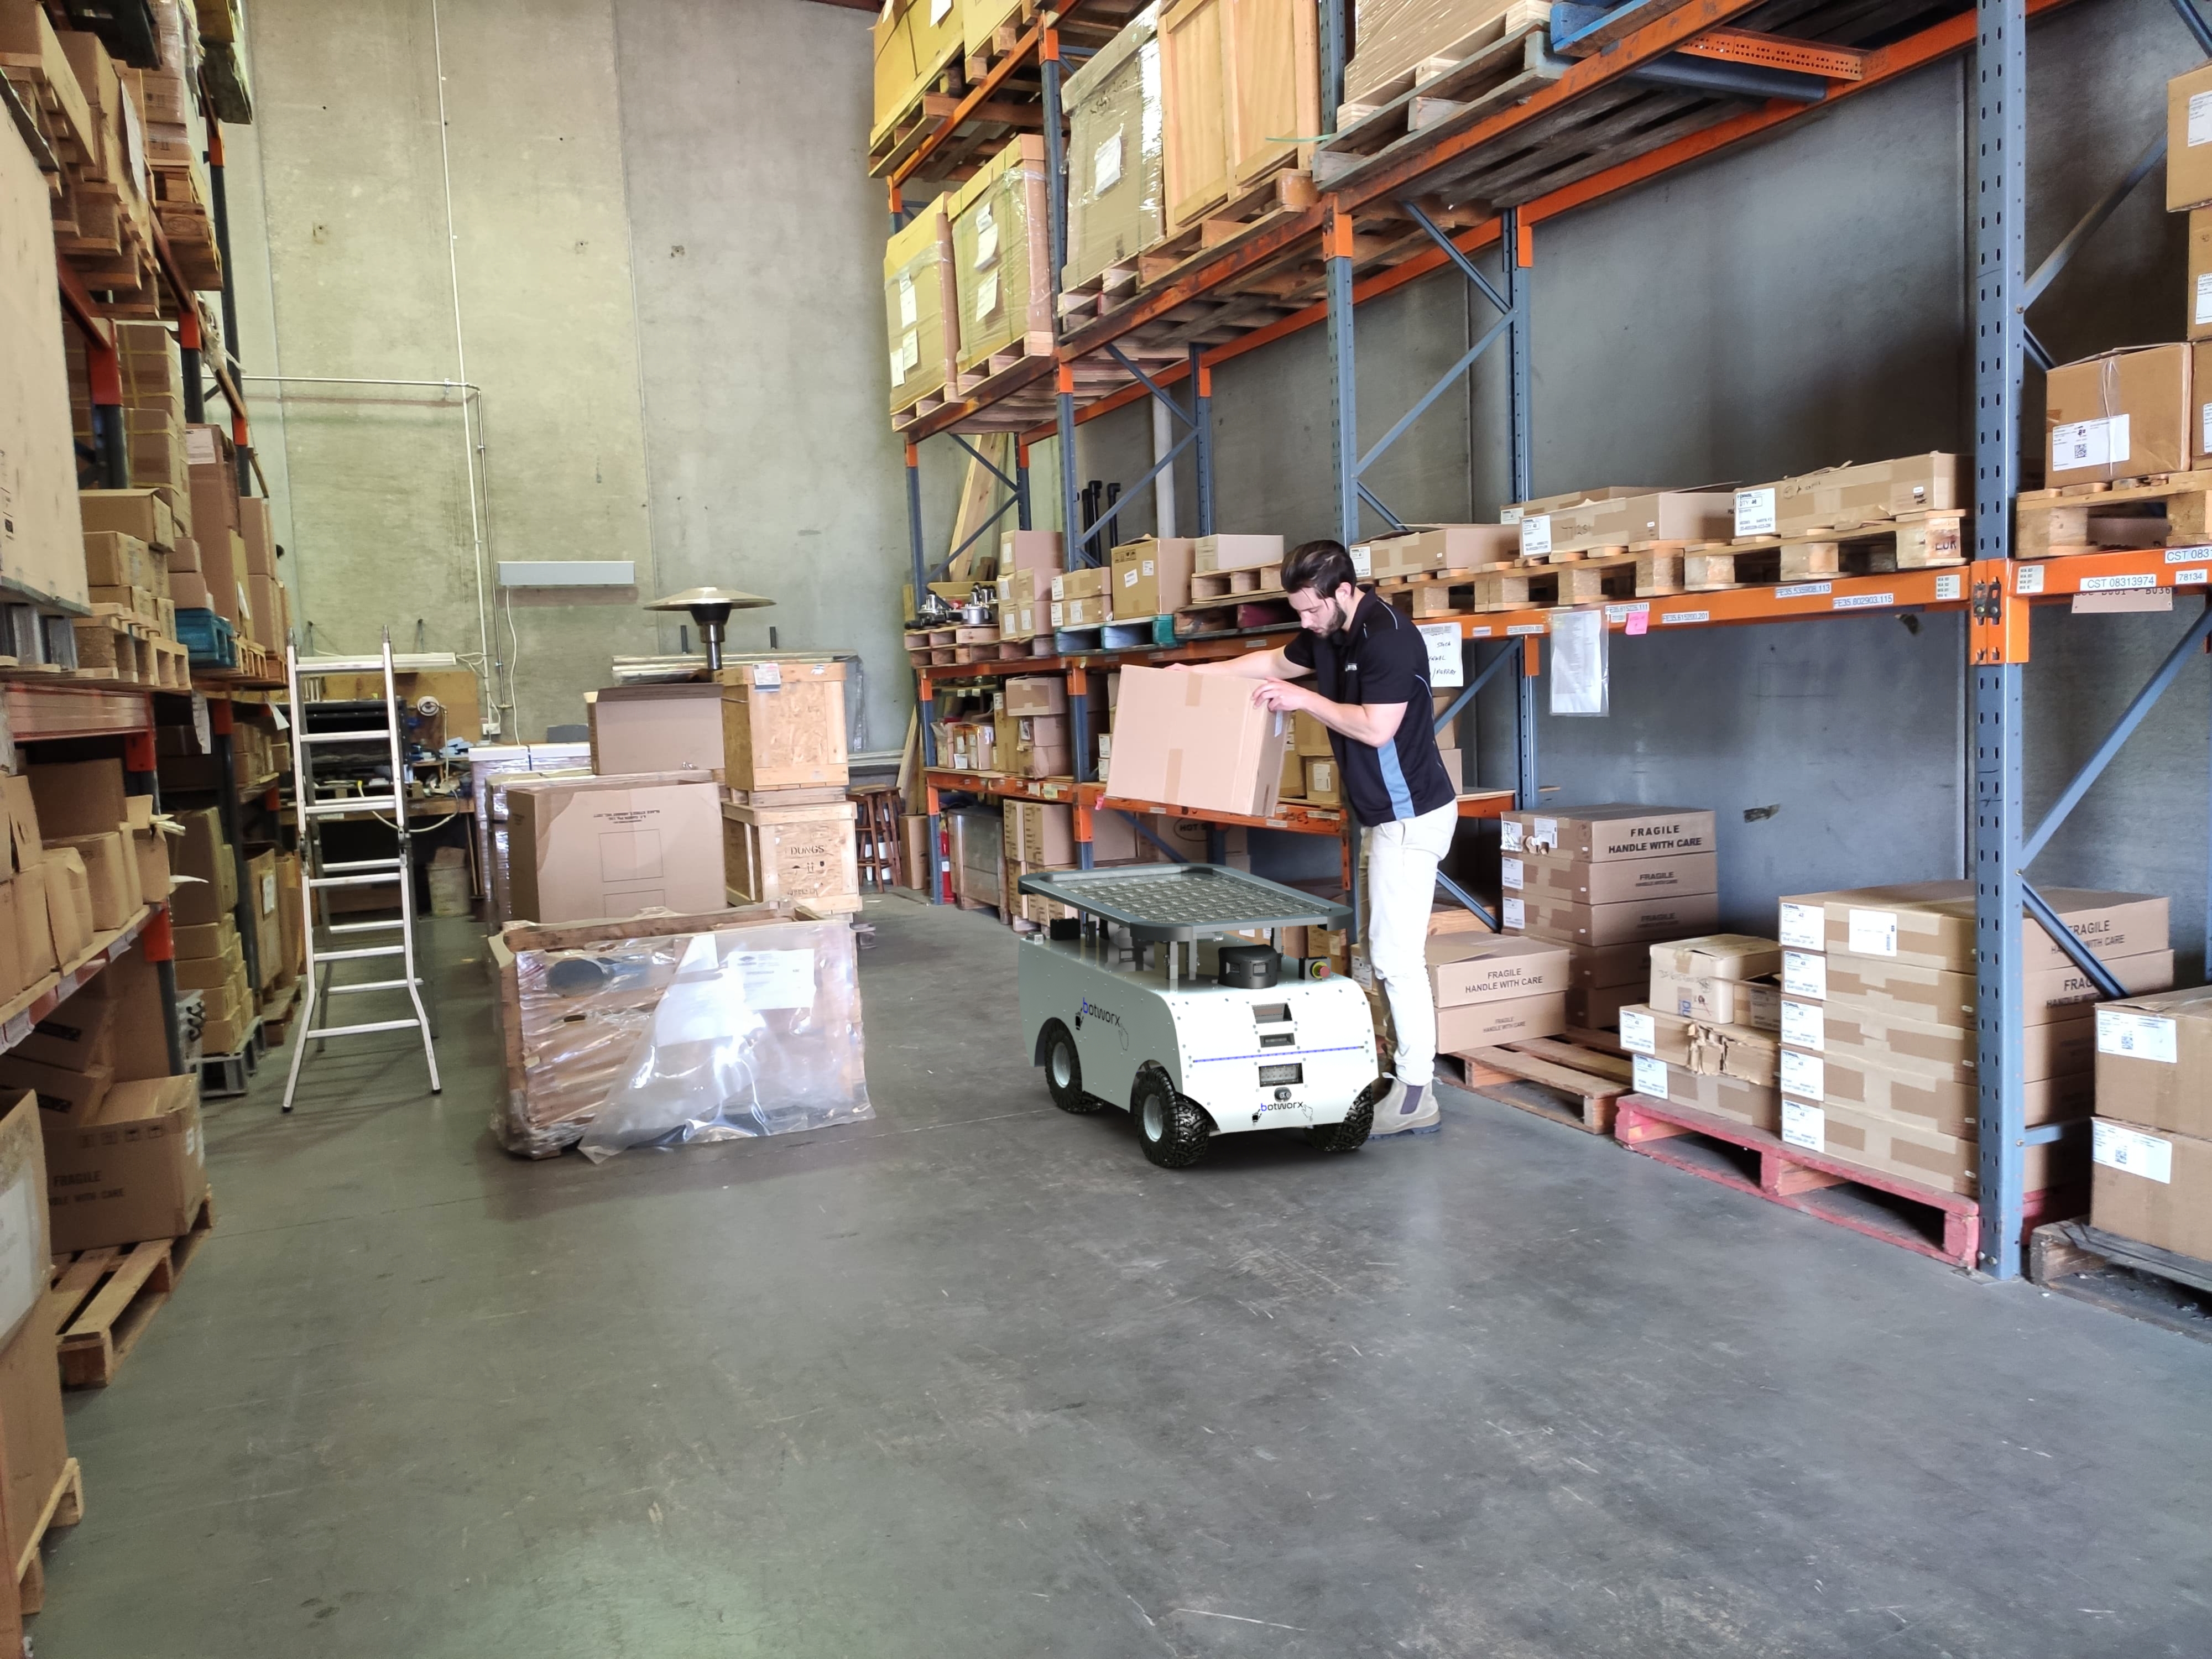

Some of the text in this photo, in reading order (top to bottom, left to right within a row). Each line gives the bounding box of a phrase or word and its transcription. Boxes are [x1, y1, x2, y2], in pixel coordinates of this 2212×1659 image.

[2167, 551, 2188, 561] CST
[2088, 576, 2154, 588] CST 08313974
[2179, 572, 2203, 581] 78134
[1180, 823, 1197, 832] HOT
[1630, 825, 1680, 837] FRAGILE
[791, 845, 825, 855] DUNGS
[1609, 837, 1702, 853] HANDLE WITH CARE
[1640, 872, 1674, 880] FRAGILE
[1641, 912, 1676, 922] FRAGILE
[2105, 934, 2125, 946] CARE
[1488, 968, 1521, 979] FRAGILE
[1465, 976, 1544, 994] HANDLE WITH CARE
[1083, 997, 1120, 1028] botworx
[1261, 1101, 1303, 1112] botworx
[54, 1171, 102, 1187] FRAGILE
